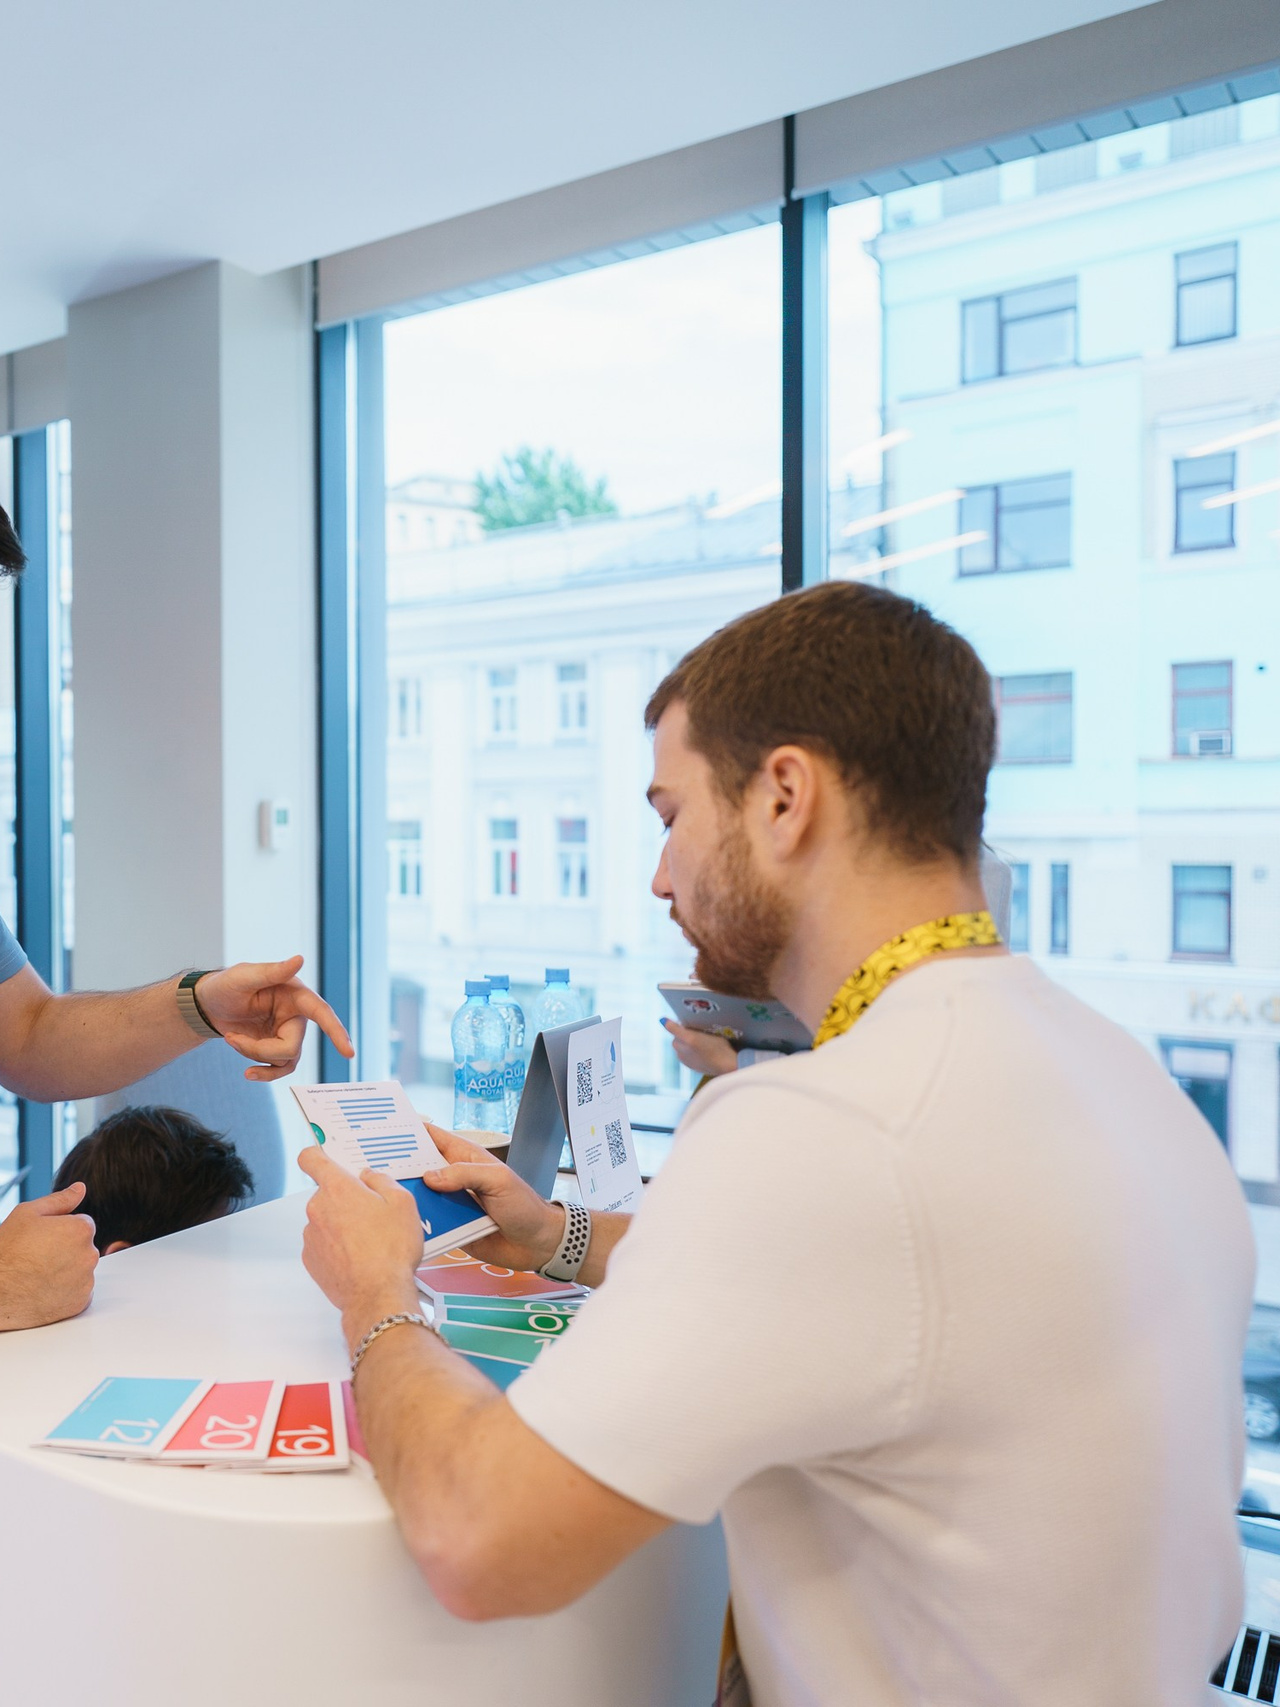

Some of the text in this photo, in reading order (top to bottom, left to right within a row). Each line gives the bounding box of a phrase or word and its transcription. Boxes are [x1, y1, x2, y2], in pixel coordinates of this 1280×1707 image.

[99, 1418, 160, 1442] 12
[199, 1414, 258, 1450] 20
[276, 1424, 332, 1457] 19
